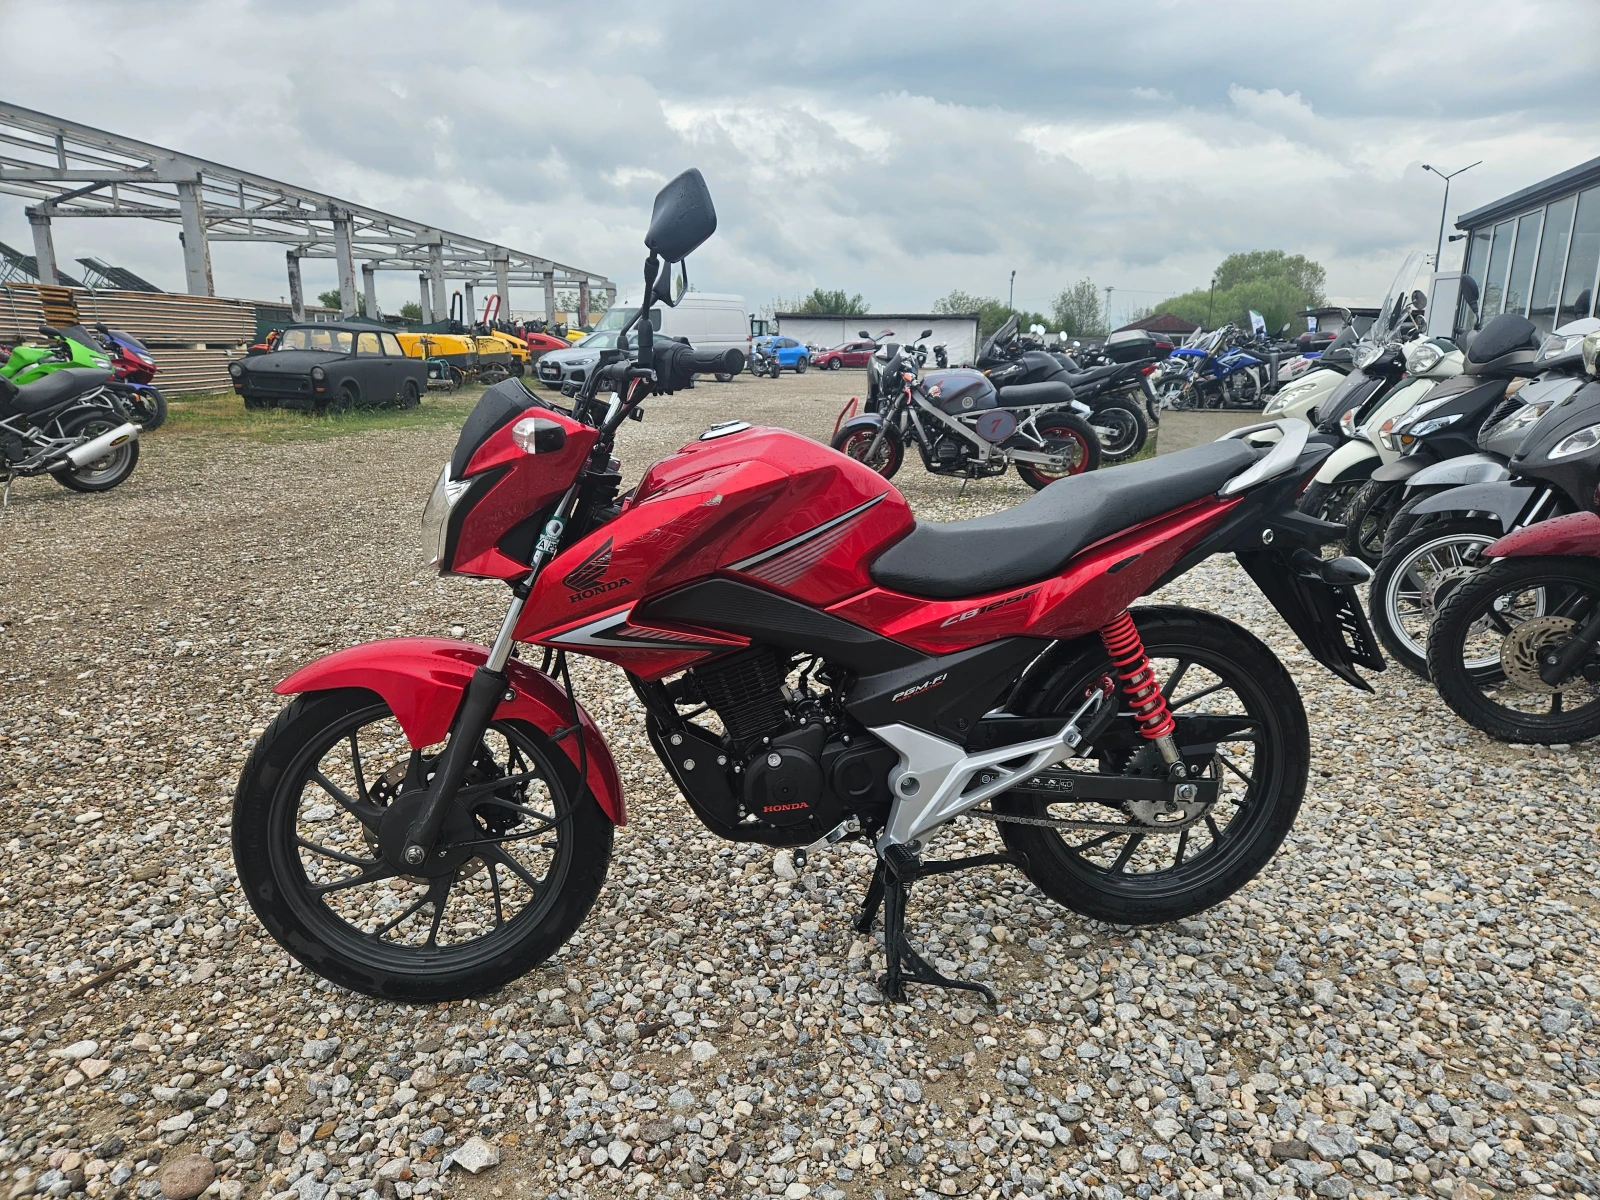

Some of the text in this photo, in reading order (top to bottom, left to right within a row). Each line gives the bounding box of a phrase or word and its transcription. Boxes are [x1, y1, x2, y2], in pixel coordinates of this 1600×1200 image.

[991, 418, 1003, 434] 7
[568, 577, 633, 604] HONDA
[940, 587, 1042, 628] CB125F
[763, 801, 810, 813] HONDA
